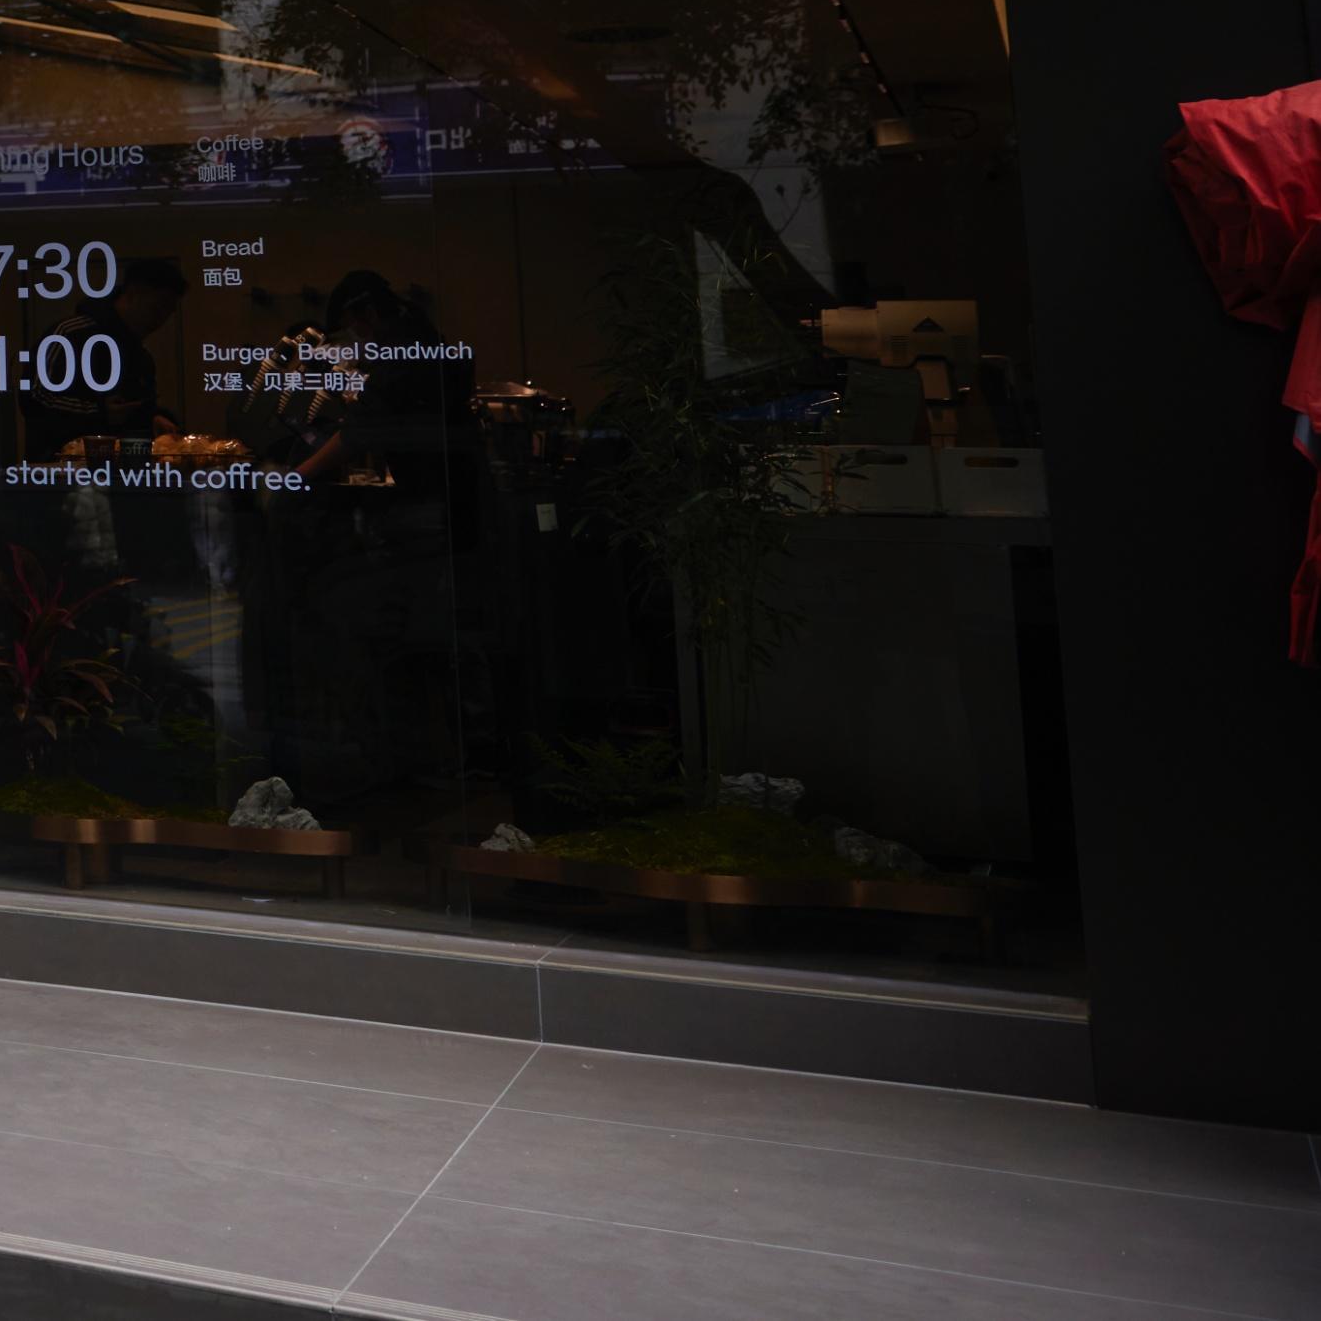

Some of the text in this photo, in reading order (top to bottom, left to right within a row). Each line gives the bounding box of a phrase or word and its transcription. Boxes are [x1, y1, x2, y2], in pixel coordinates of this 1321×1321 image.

[197, 135, 264, 154] Coffee
[58, 142, 144, 168] Hours
[198, 163, 237, 182] 咖啡
[202, 237, 264, 257] Bread
[203, 267, 243, 287] 面包
[298, 341, 359, 365] Bagel
[364, 340, 474, 361] Sandwich
[203, 372, 365, 392] 汉堡、贝果三明治
[5, 460, 111, 487] started
[120, 461, 182, 488] with
[190, 462, 312, 492] coffree.
